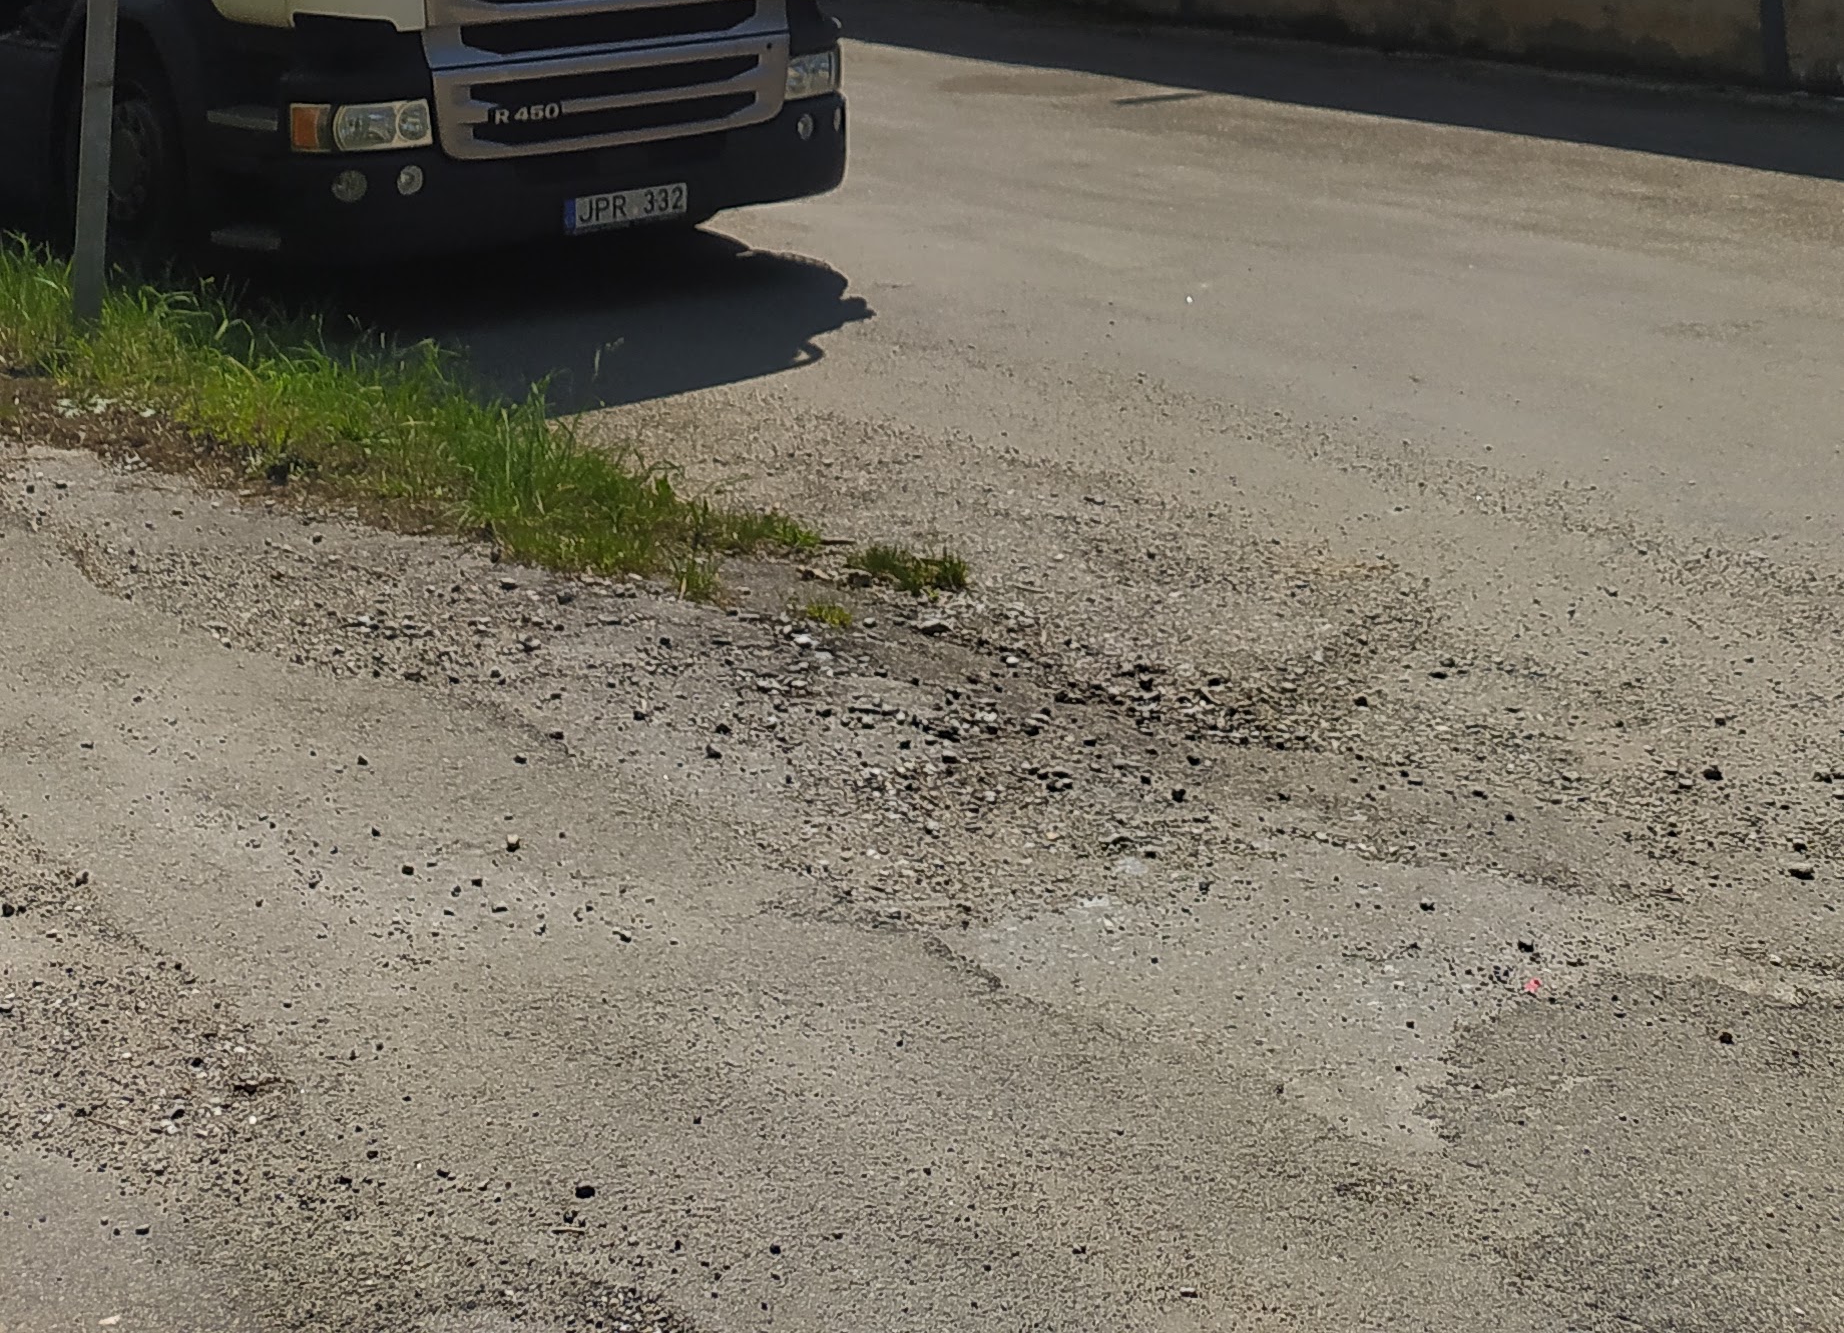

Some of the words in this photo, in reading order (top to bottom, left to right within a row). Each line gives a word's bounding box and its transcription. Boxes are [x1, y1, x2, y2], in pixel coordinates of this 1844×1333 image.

[495, 109, 510, 125] R
[514, 103, 560, 122] 450
[579, 195, 627, 222] JPR
[643, 185, 684, 214] 332
